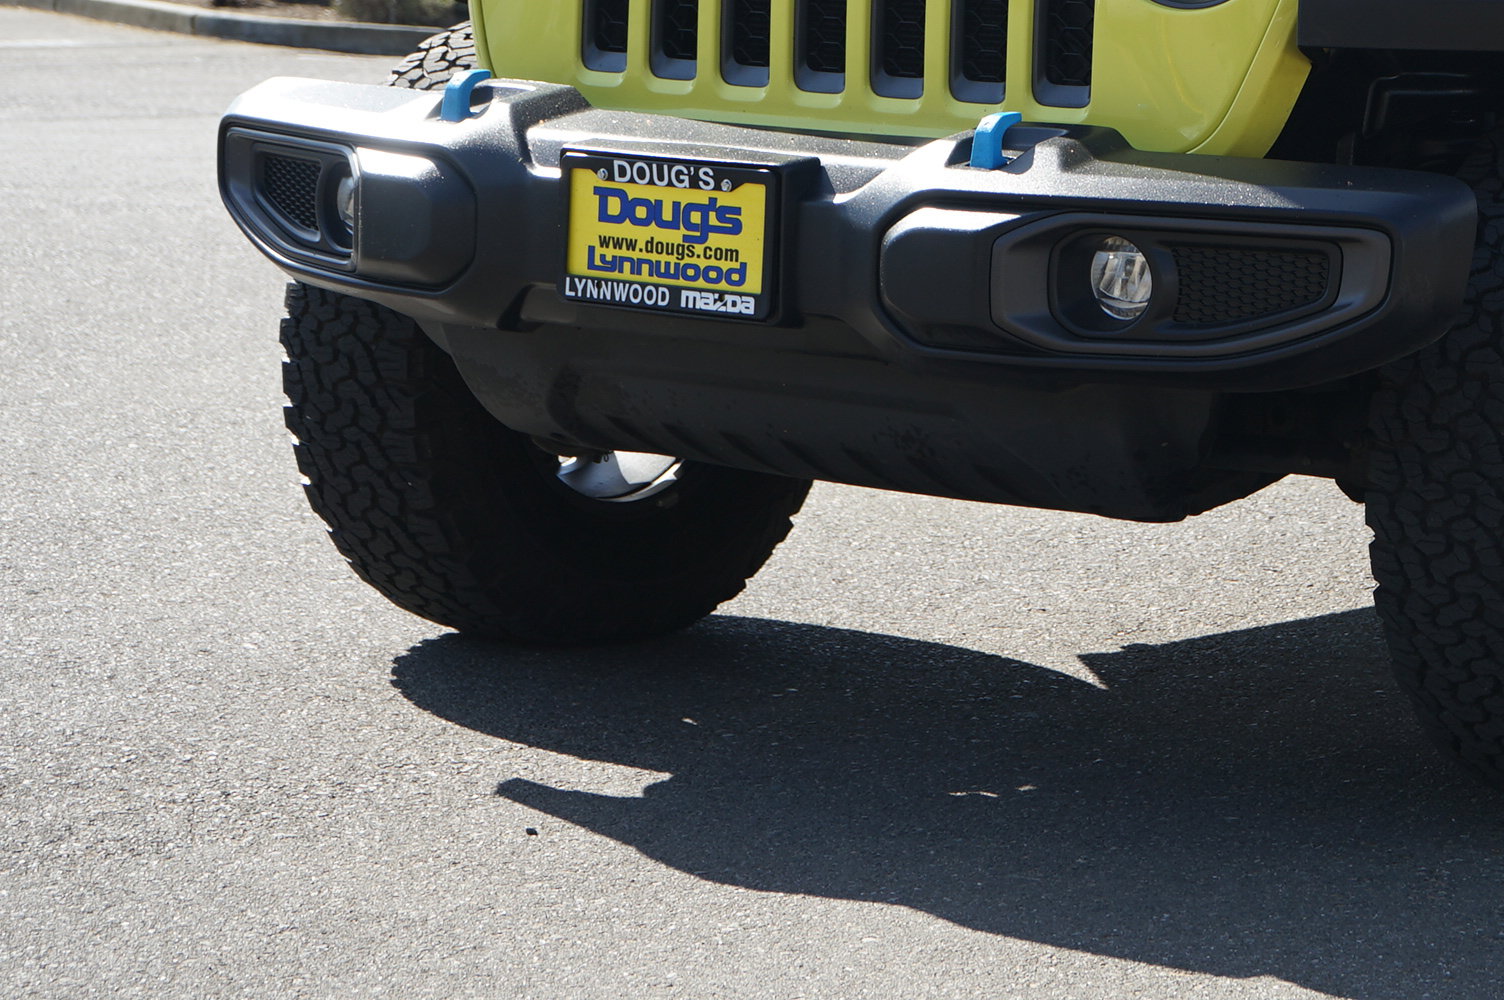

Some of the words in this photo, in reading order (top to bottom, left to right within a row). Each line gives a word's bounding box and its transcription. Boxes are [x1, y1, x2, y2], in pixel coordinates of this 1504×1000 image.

[613, 160, 715, 191] DOUG'S
[598, 234, 740, 263] www.dougs.com
[587, 245, 748, 287] Lynnwood
[565, 277, 670, 306] LYNNWOOD
